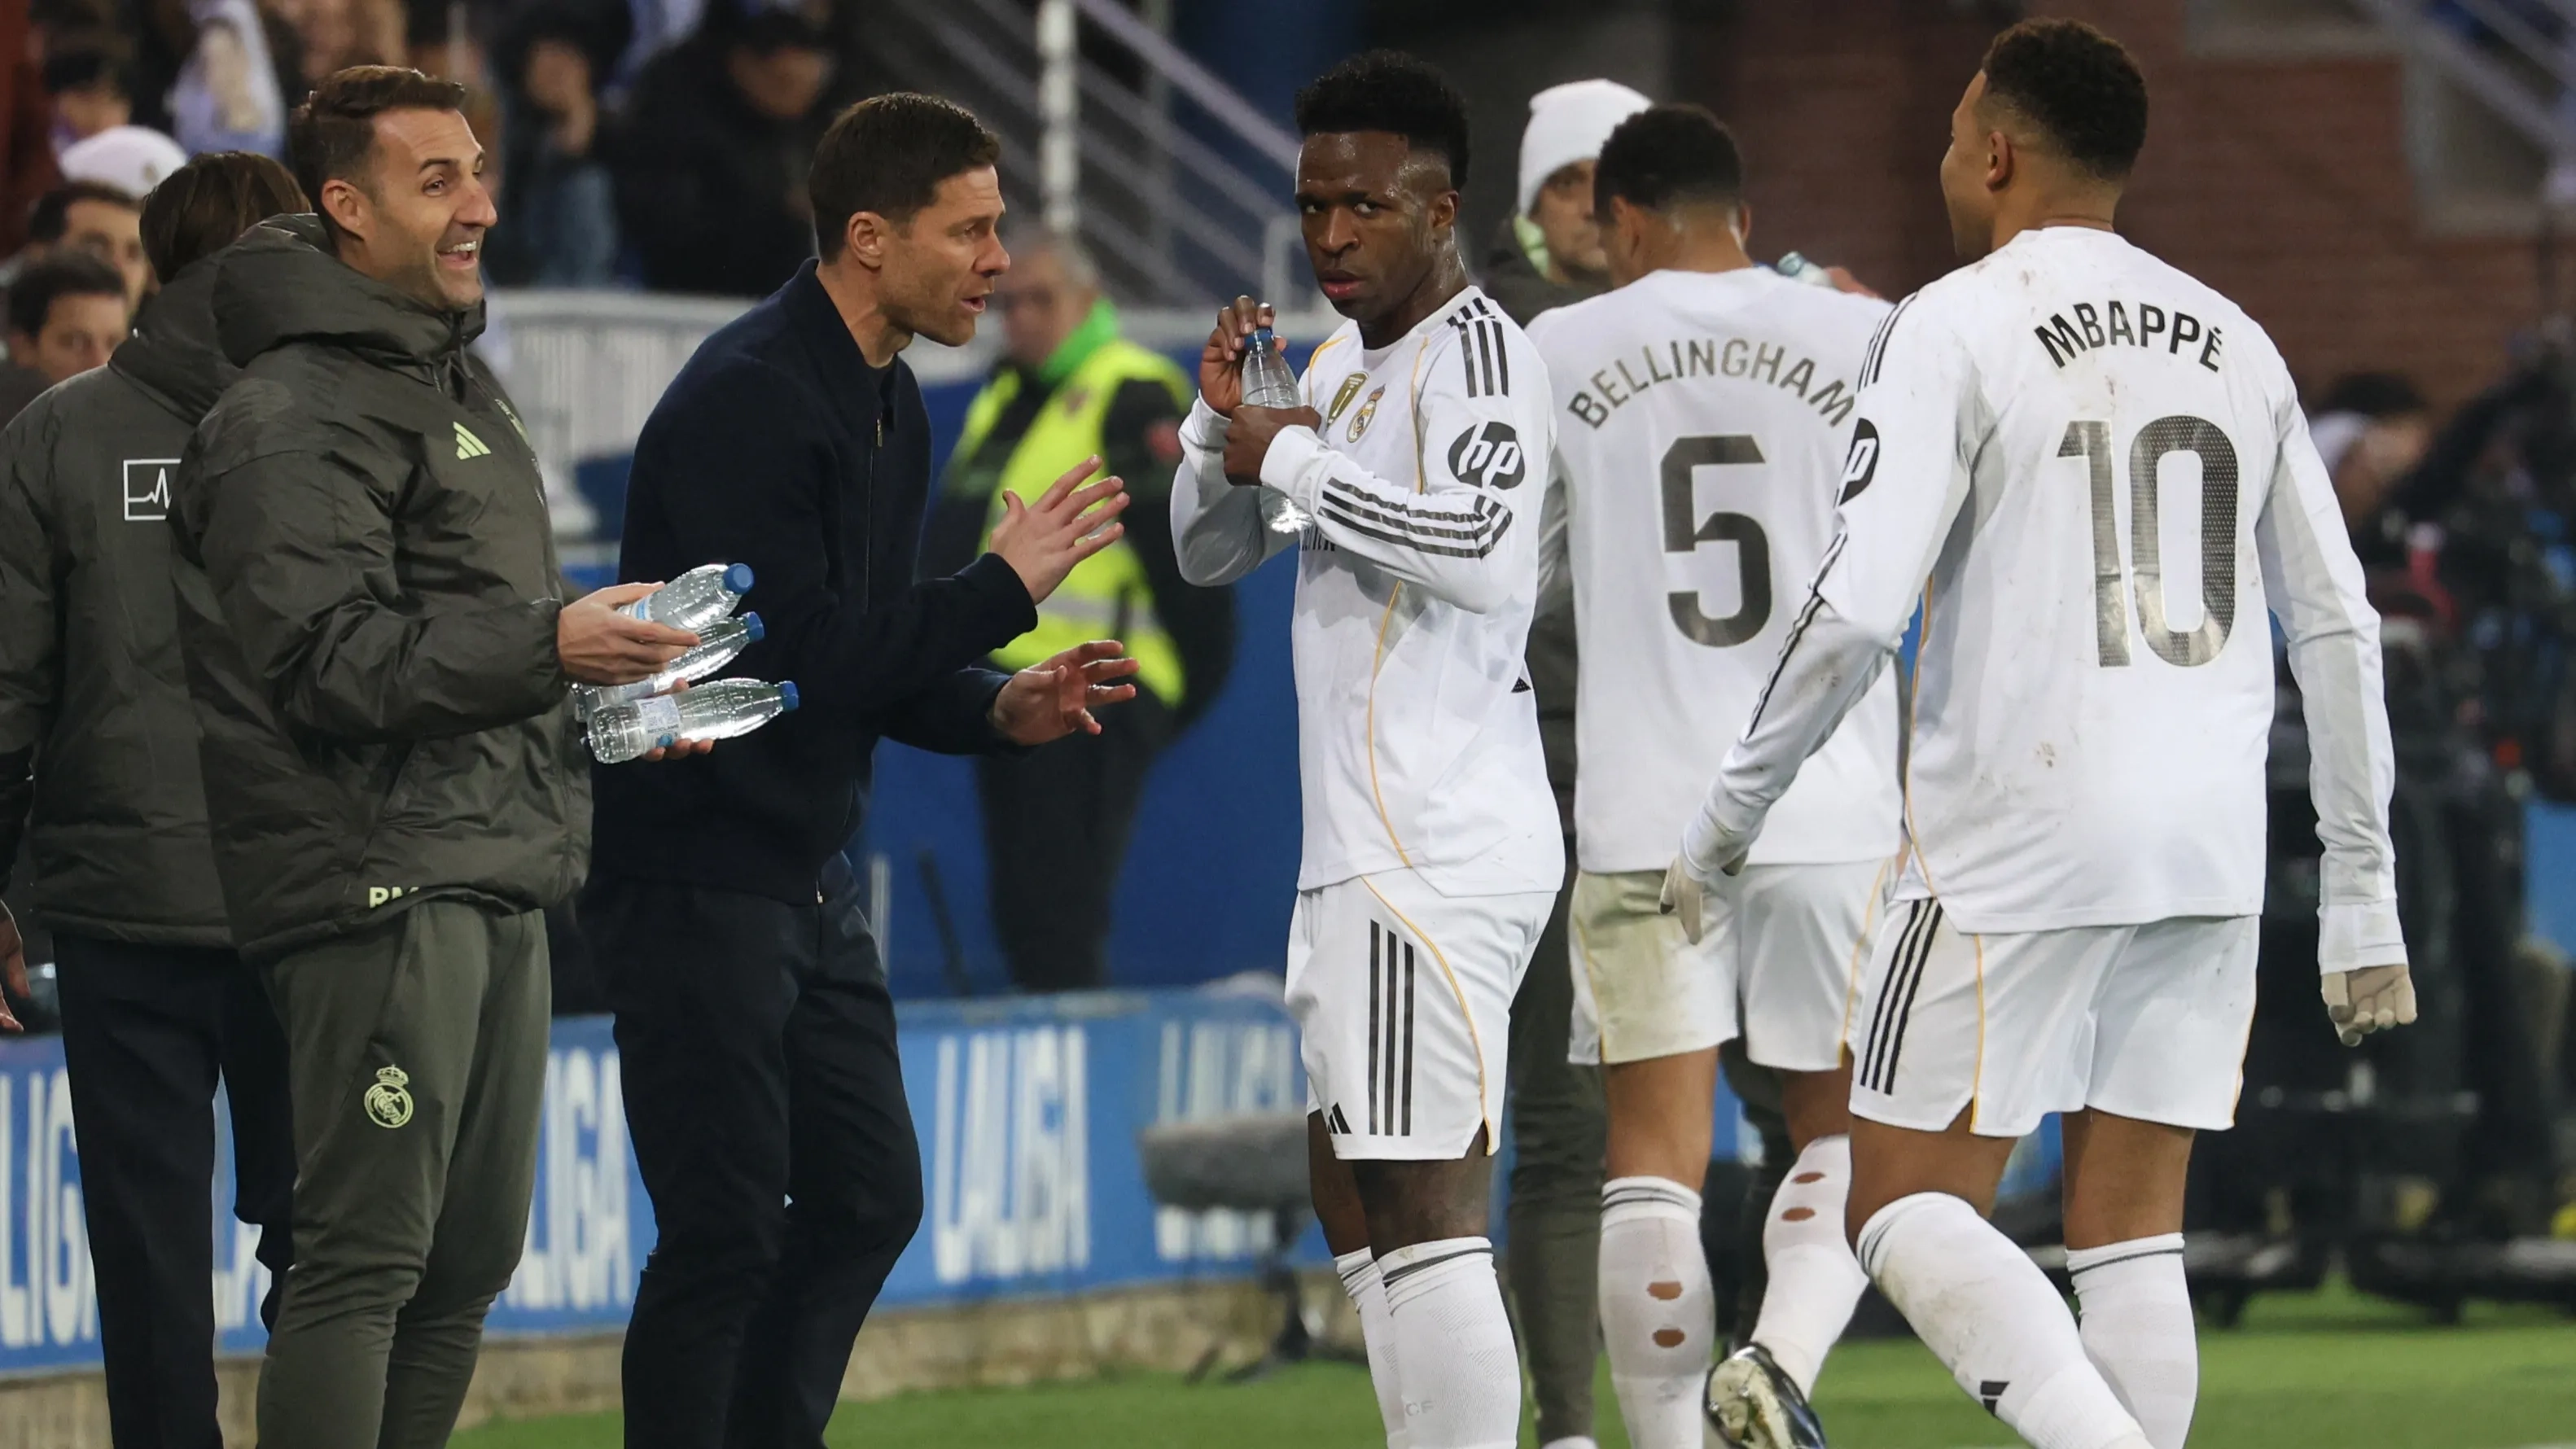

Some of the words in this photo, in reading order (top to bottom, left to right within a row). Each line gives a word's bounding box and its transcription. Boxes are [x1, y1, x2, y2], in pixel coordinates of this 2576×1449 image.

[2035, 300, 2223, 372] MBAPPÉ
[1567, 338, 1855, 428] BELLINGHAM
[1456, 422, 1522, 489] hp
[1661, 435, 1771, 647] 5
[2057, 415, 2238, 668] 10
